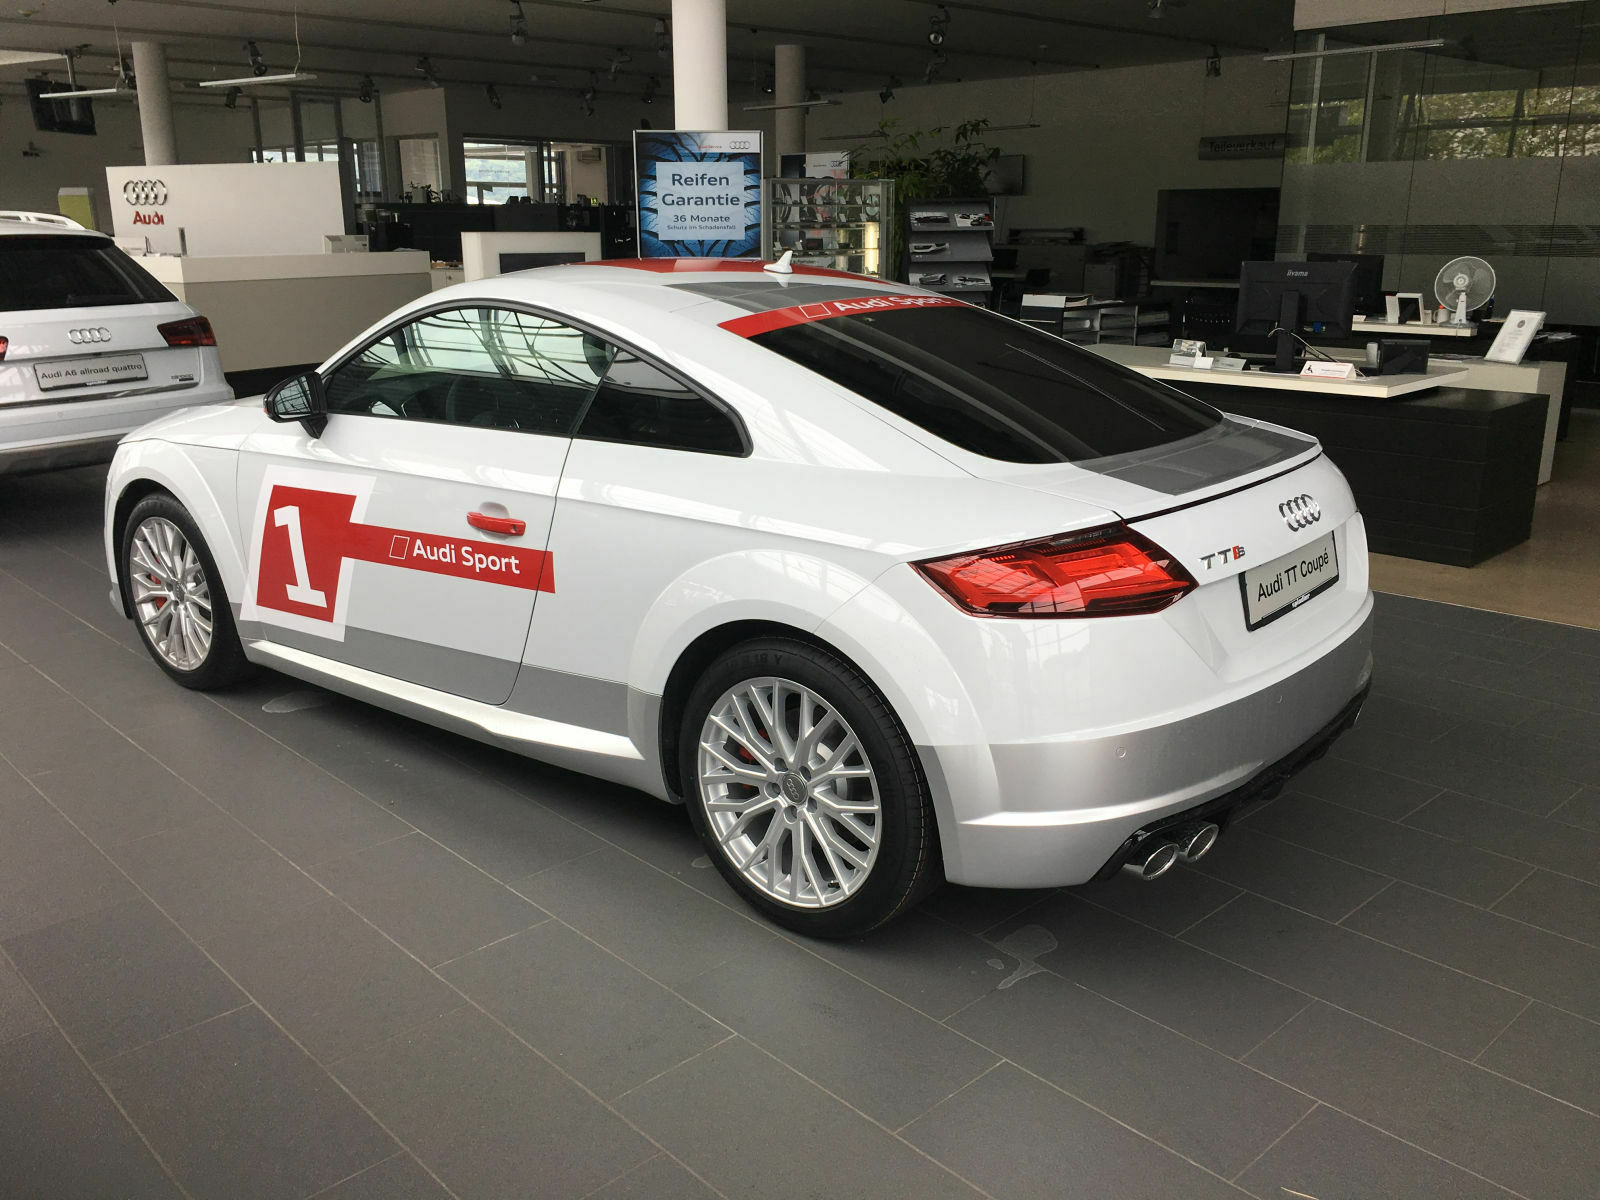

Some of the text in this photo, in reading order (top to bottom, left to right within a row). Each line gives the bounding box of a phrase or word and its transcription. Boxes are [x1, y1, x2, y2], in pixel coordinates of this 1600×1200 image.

[672, 174, 729, 186] Reifen
[662, 194, 740, 206] Garantie
[132, 210, 165, 225] Audi
[673, 214, 731, 223] 36 Monate
[833, 299, 893, 311] Audi
[41, 362, 143, 380] Audi A6 allroad quattro
[273, 505, 328, 609] 1
[412, 538, 521, 576] Audi Sport
[1257, 572, 1284, 602] Audi
[1284, 564, 1298, 586] TT
[1299, 547, 1329, 579] Coupé
